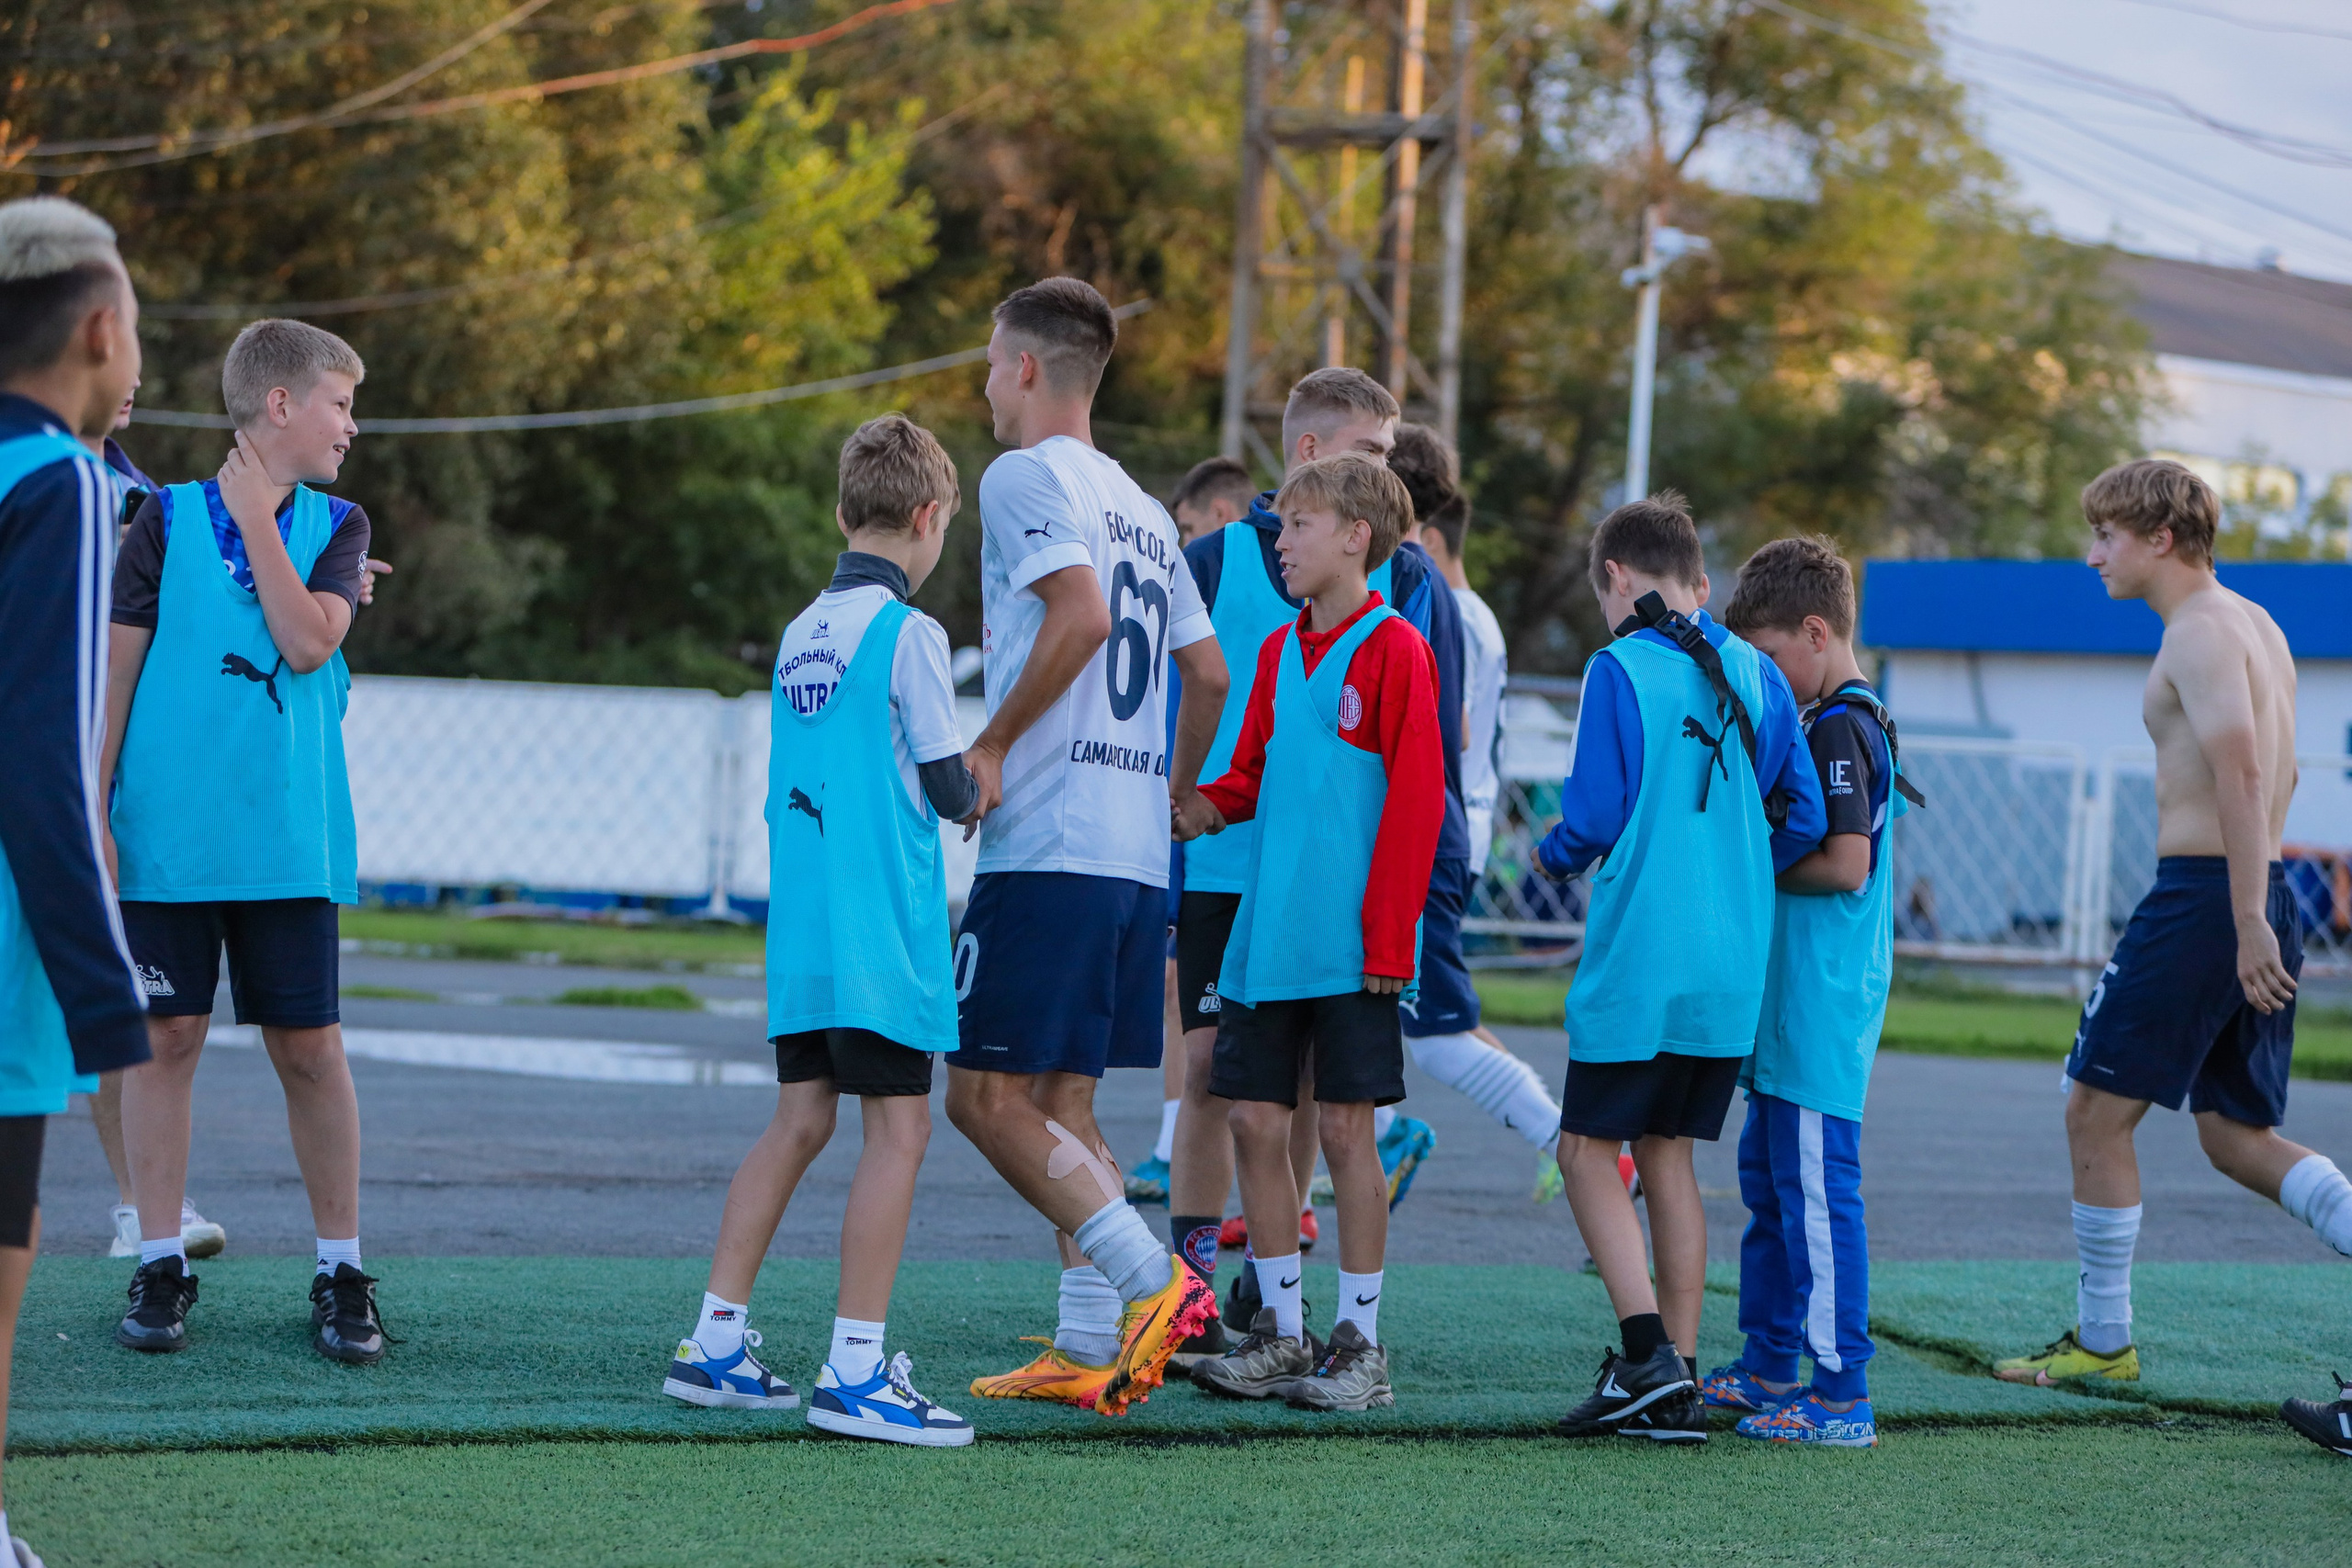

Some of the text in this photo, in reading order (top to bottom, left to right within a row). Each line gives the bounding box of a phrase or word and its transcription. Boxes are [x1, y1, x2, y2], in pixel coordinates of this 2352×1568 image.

[1070, 739, 1167, 776] САМАРСКАЯ О
[141, 979, 175, 995] TRA
[1198, 996, 1221, 1012] UL
